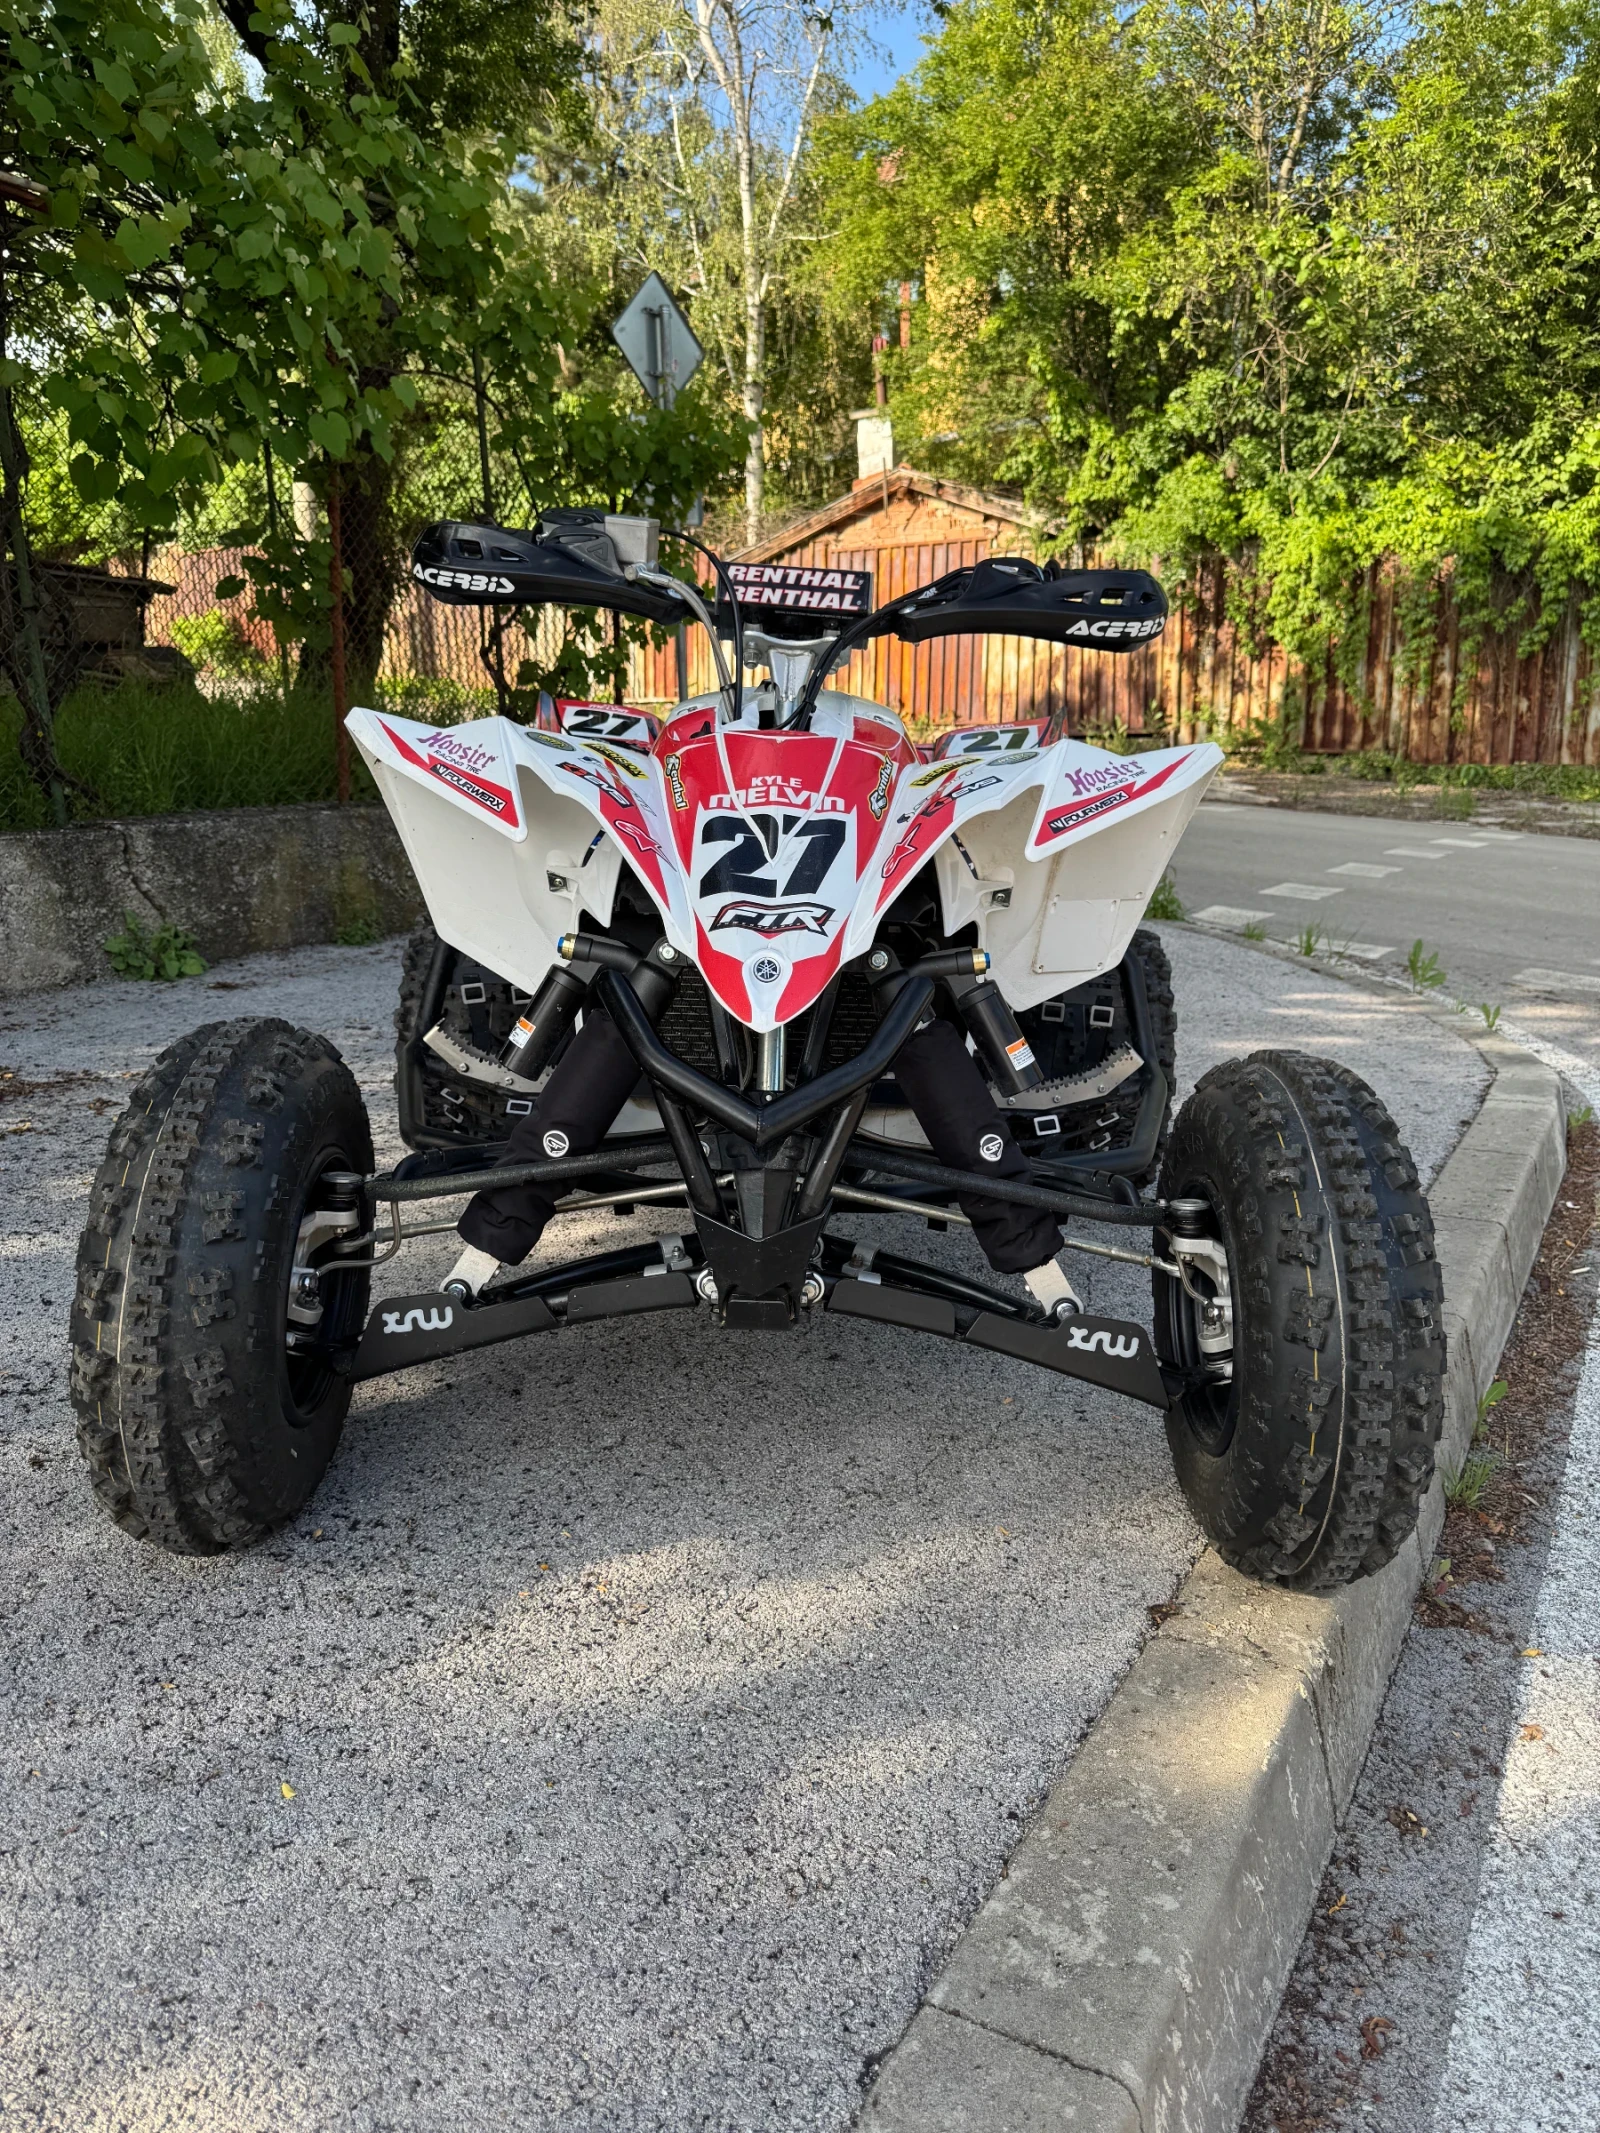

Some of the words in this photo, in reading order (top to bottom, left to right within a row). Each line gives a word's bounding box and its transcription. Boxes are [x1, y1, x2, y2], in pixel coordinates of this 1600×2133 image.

[727, 565, 862, 590] RENTHAL
[724, 586, 860, 611] RENTHAL
[567, 708, 642, 737] 27
[416, 731, 499, 769] Hoosier
[960, 727, 1030, 753] 27
[433, 749, 464, 767] RACING
[465, 763, 482, 775] TIRE
[444, 770, 504, 810] FOURWERX
[665, 754, 688, 809] Renthal
[751, 775, 803, 788] KYLE
[1064, 760, 1144, 796] Hoosier
[1095, 776, 1129, 793] RACING
[1129, 768, 1148, 779] TIRE
[1062, 792, 1128, 826] FOURWERX
[699, 813, 847, 899] 27
